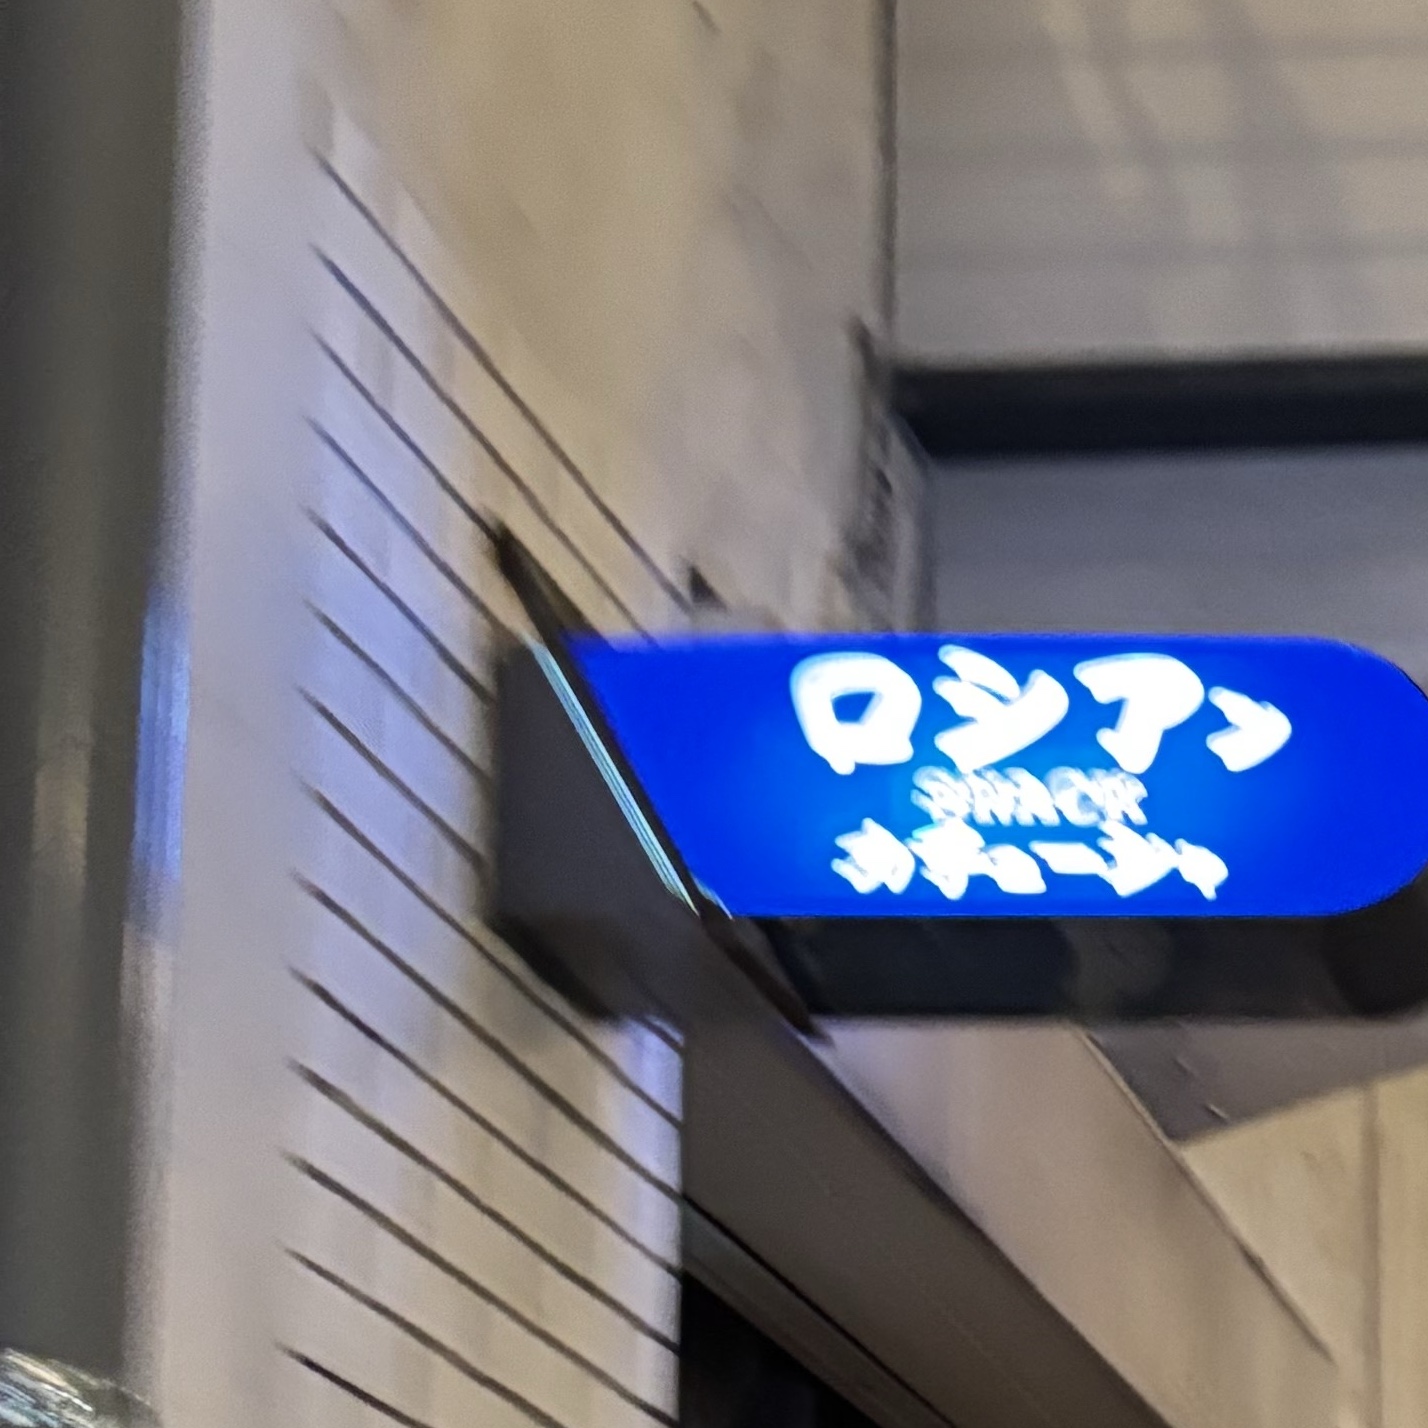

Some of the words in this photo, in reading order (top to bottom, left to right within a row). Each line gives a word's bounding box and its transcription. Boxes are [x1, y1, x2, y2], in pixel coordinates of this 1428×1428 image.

[789, 644, 1294, 775] ロシアン
[910, 765, 1149, 828] SNACK
